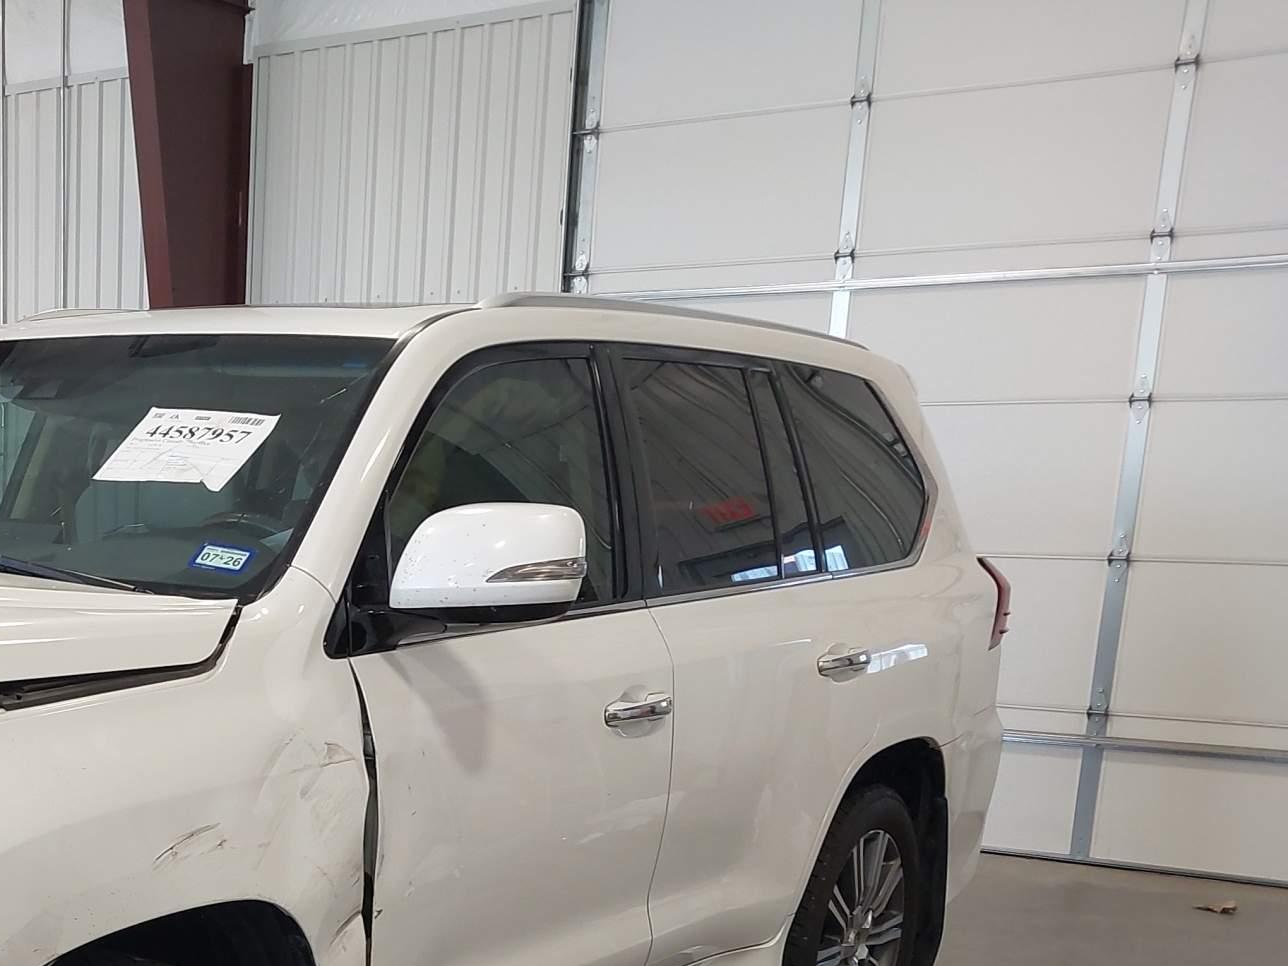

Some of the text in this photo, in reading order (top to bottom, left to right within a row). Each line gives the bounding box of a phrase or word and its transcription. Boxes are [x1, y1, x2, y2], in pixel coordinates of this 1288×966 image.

[145, 424, 254, 444] 44587957
[200, 552, 220, 563] 07
[223, 556, 243, 567] 26
